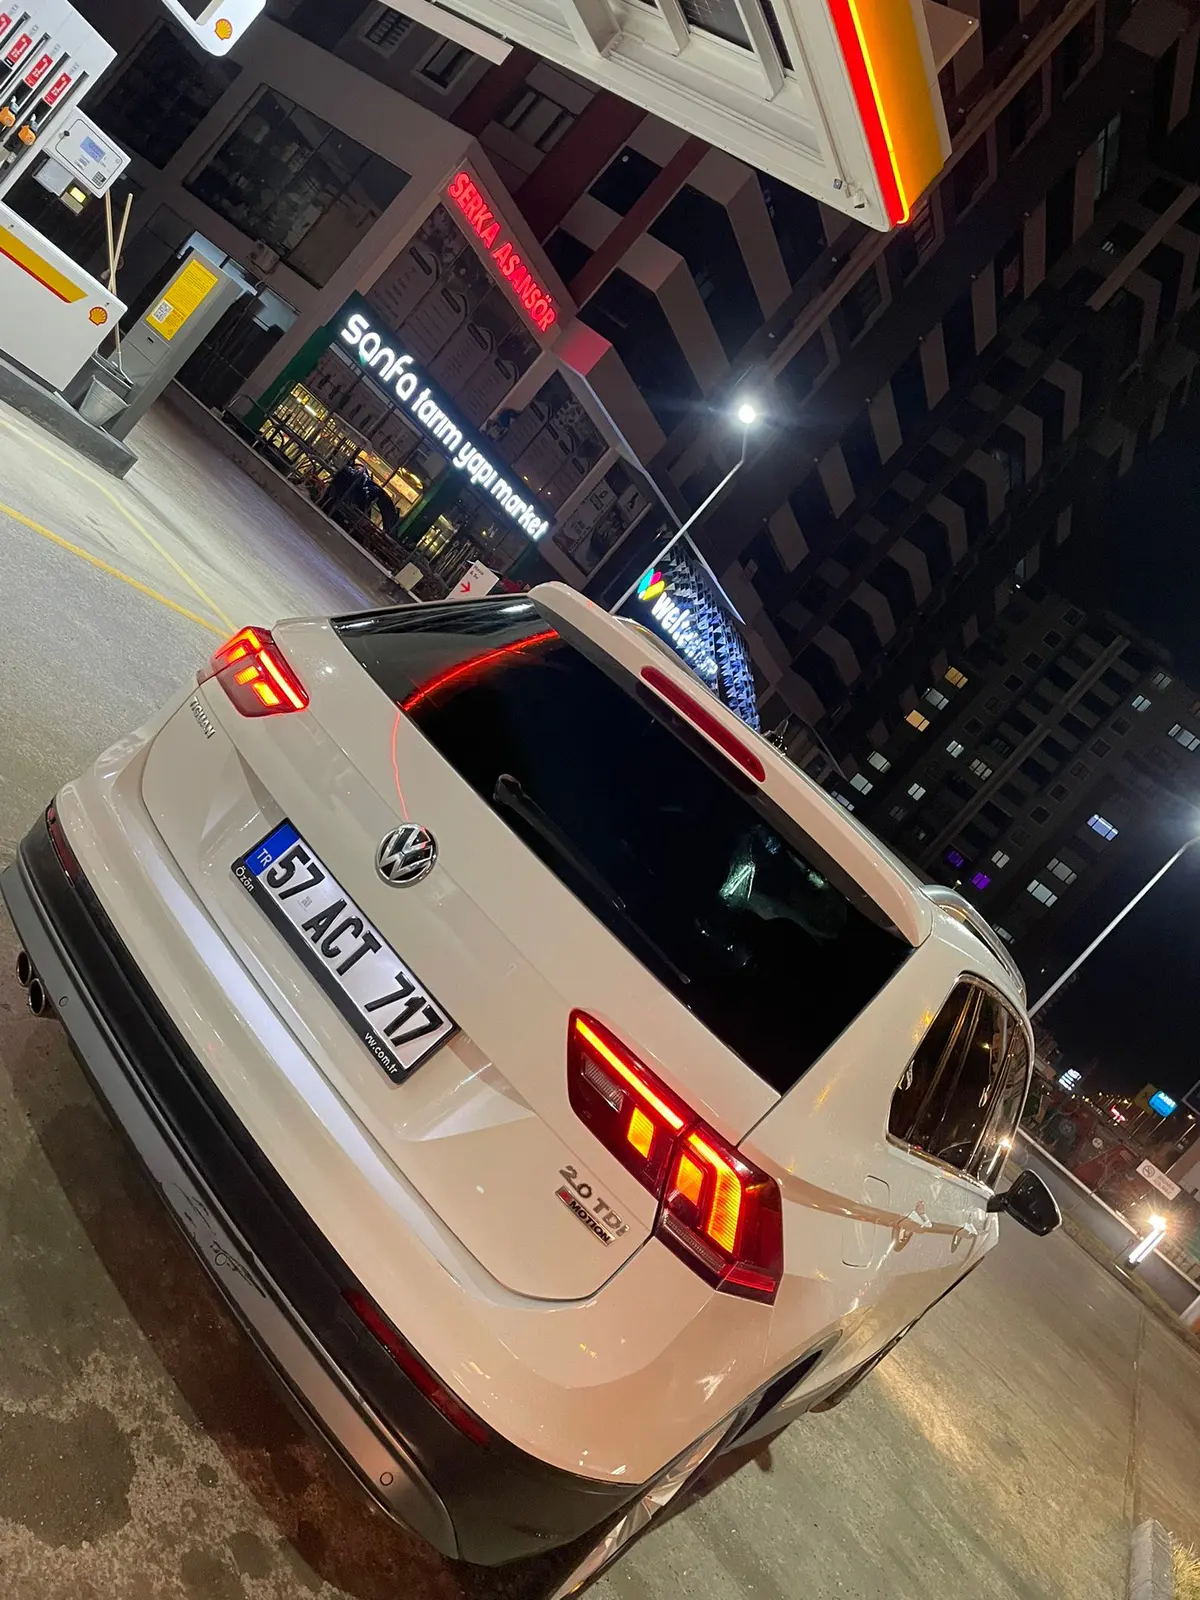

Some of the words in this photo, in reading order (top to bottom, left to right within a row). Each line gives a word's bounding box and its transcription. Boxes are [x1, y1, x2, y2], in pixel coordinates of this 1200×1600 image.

[448, 171, 501, 249] SERKA
[492, 242, 558, 333] ASANSÖR
[340, 312, 417, 398] sanfa
[410, 387, 464, 450] tarım
[453, 437, 496, 489] yapı
[491, 477, 549, 542] market
[189, 695, 216, 740] TIGUAN
[256, 847, 273, 866] TR
[266, 843, 327, 902] 57
[301, 898, 384, 976] ACT
[364, 970, 444, 1048] 717
[363, 1030, 399, 1076] vw.com.tr
